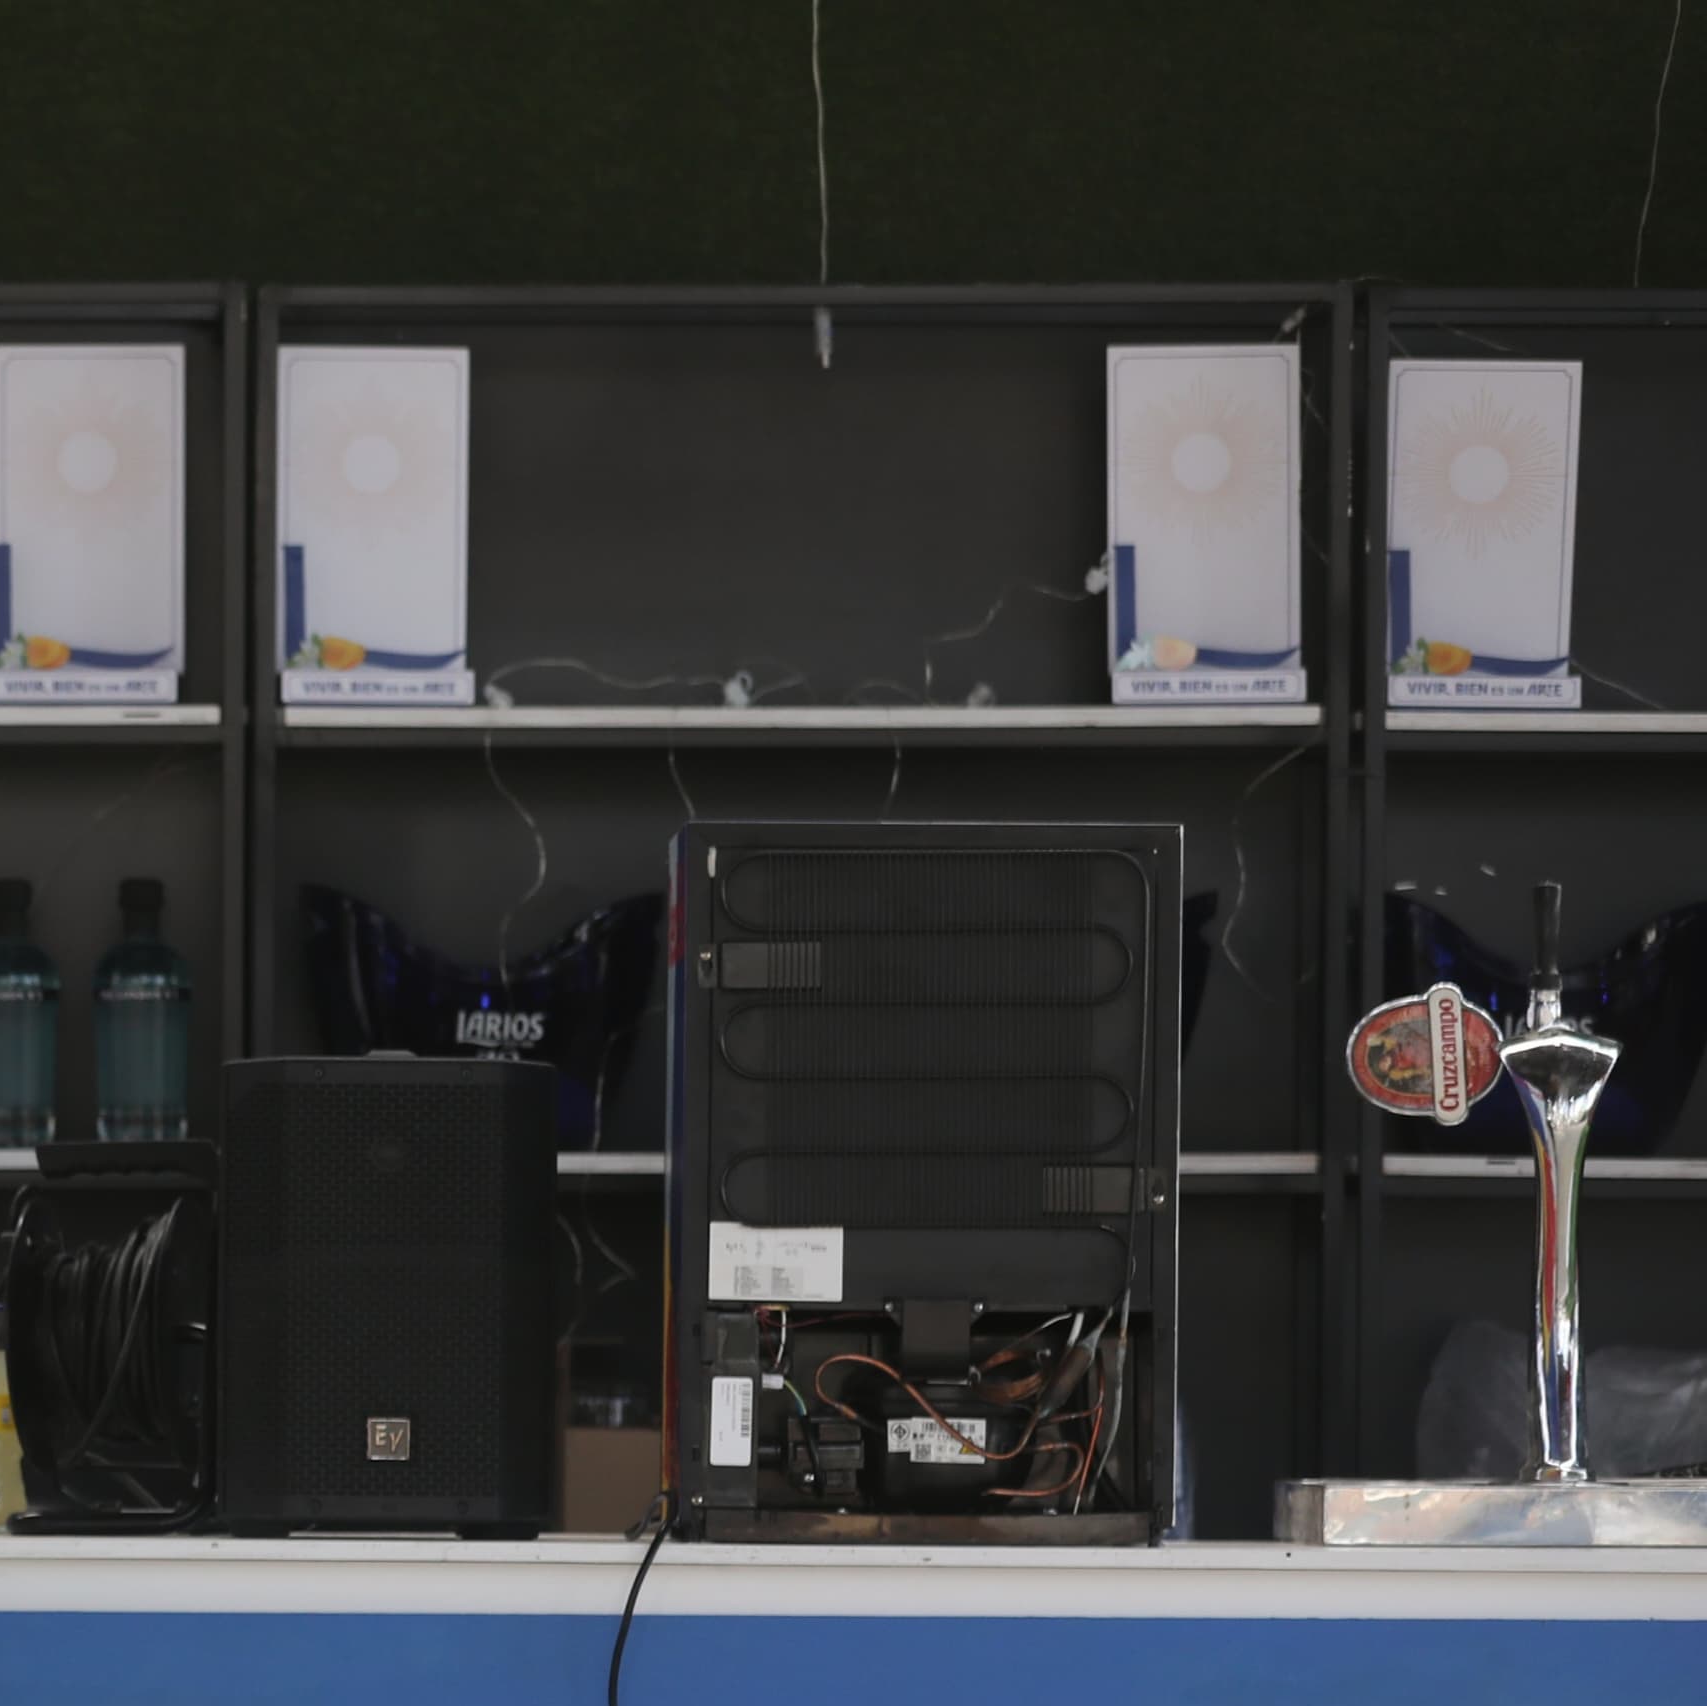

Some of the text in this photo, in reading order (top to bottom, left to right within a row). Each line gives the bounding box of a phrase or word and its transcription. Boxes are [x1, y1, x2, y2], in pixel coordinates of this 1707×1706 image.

[1178, 679, 1212, 693] BIEN
[1455, 681, 1488, 696] BIEN
[1527, 683, 1563, 697] ARTE
[456, 1009, 545, 1048] LARIOS
[1439, 998, 1461, 1112] Cruzcampo
